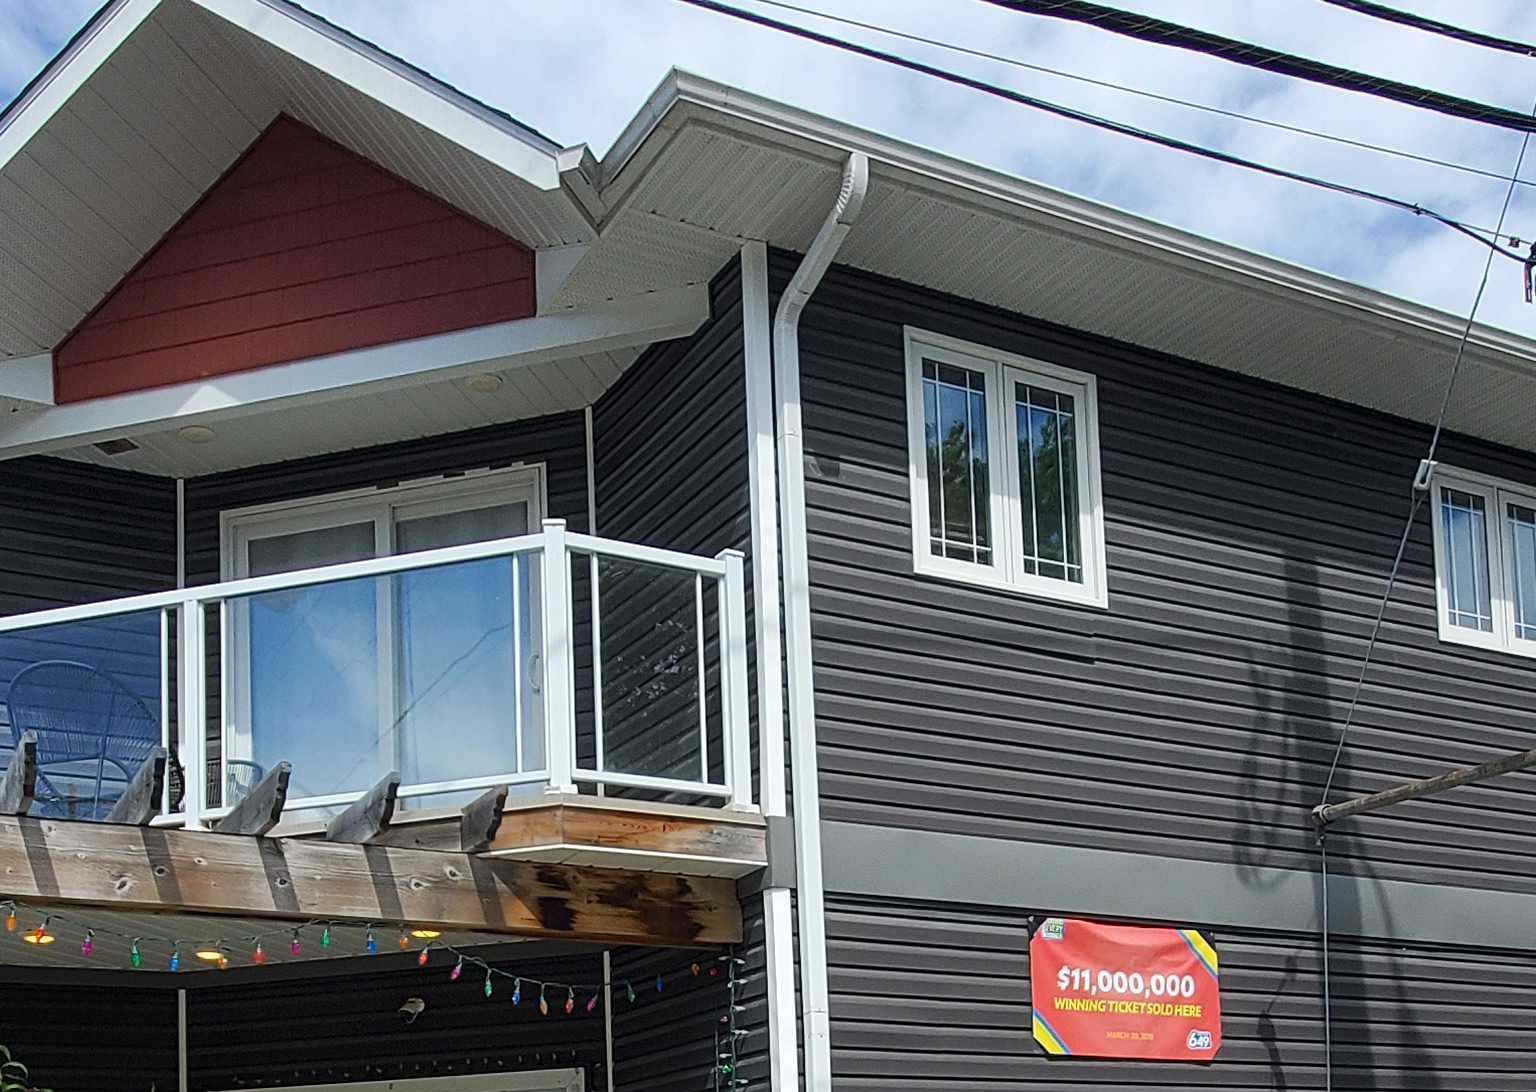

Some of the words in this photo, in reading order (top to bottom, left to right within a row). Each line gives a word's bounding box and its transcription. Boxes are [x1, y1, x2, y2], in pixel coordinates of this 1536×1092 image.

[1057, 965, 1195, 999] $11,000,000
[1054, 997, 1106, 1012] WINNING
[1107, 1001, 1146, 1014] TICKET
[1147, 1003, 1173, 1016] SOLD
[1175, 1005, 1202, 1017] HERE
